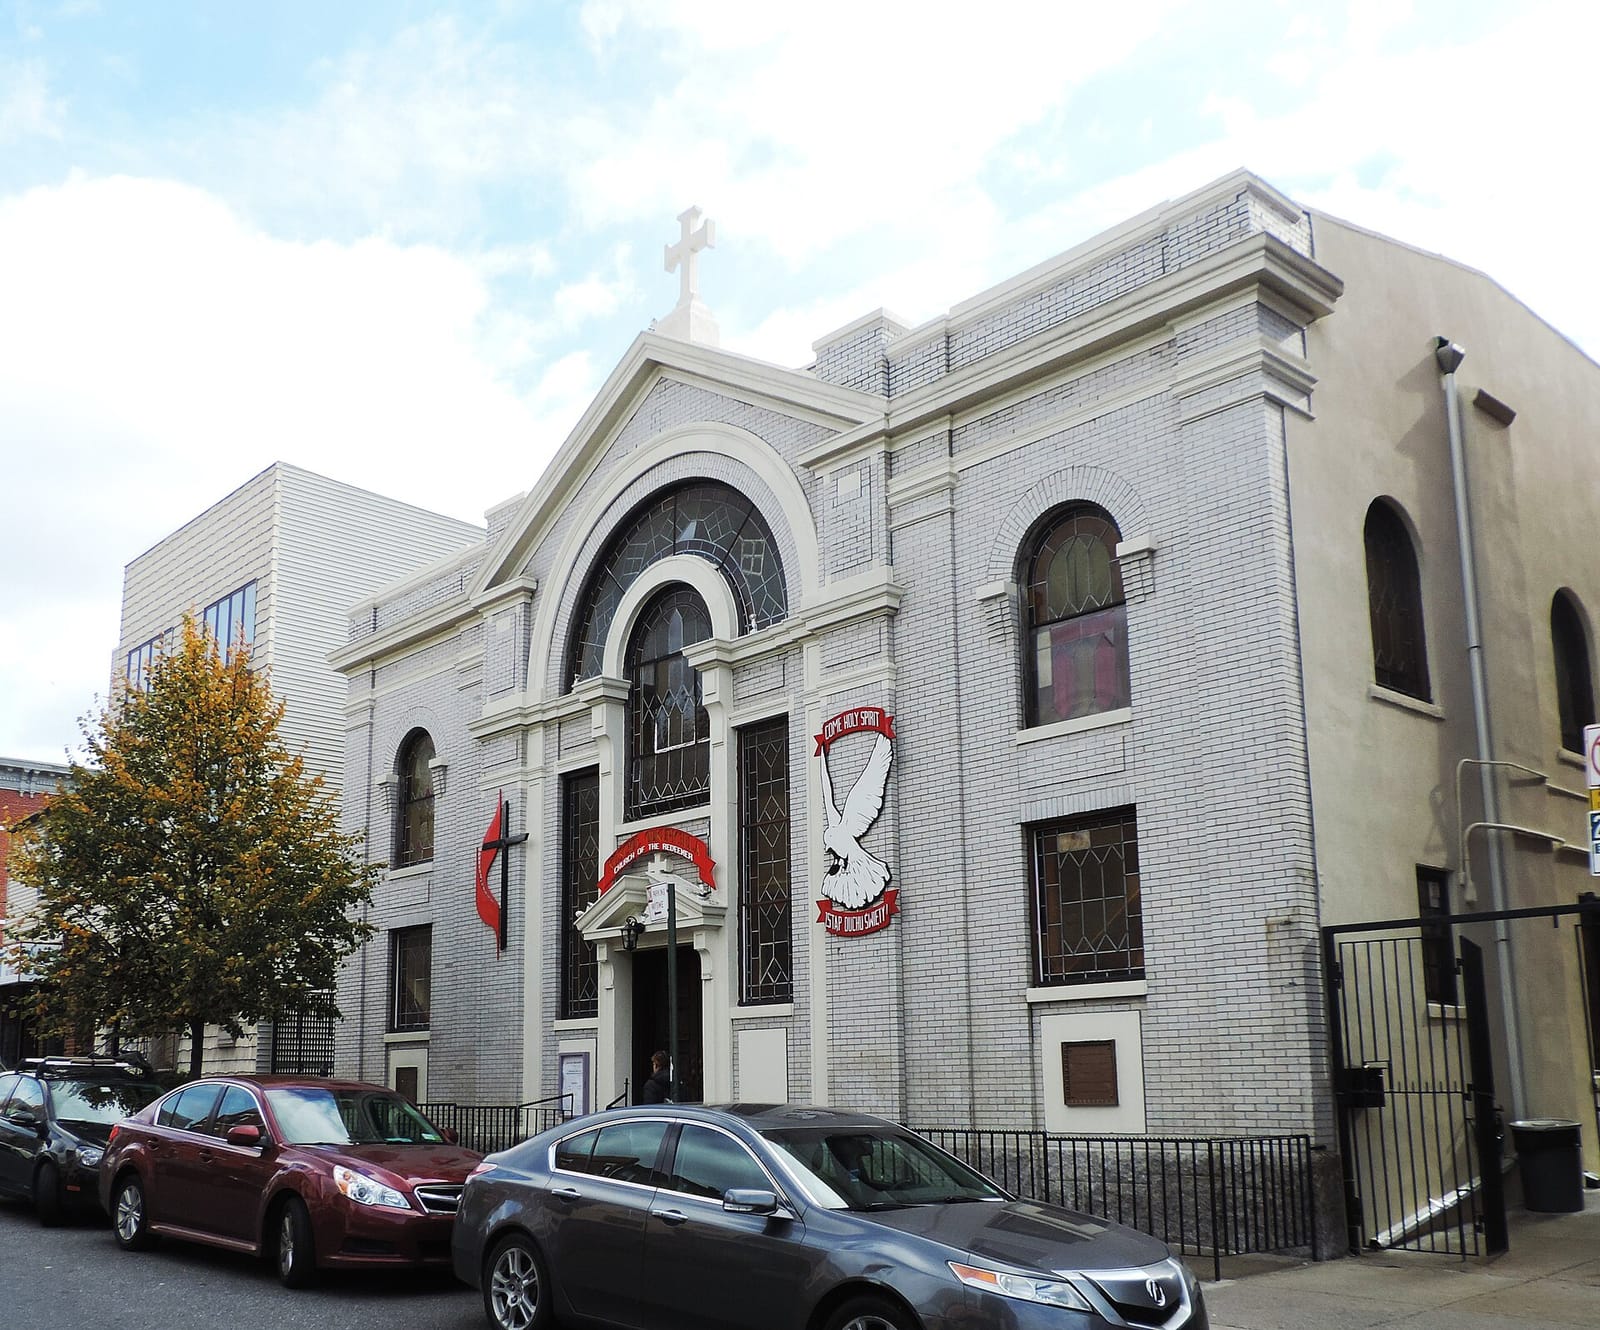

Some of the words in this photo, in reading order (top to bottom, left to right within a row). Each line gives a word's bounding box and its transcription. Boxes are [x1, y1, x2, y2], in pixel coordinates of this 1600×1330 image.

[825, 717, 842, 740] COME
[844, 711, 859, 729] HOLY
[860, 710, 880, 727] SPIRIT
[614, 851, 635, 875] CHURCH
[637, 845, 646, 855] OF
[648, 842, 660, 850] THE
[662, 843, 693, 862] REDEEMER
